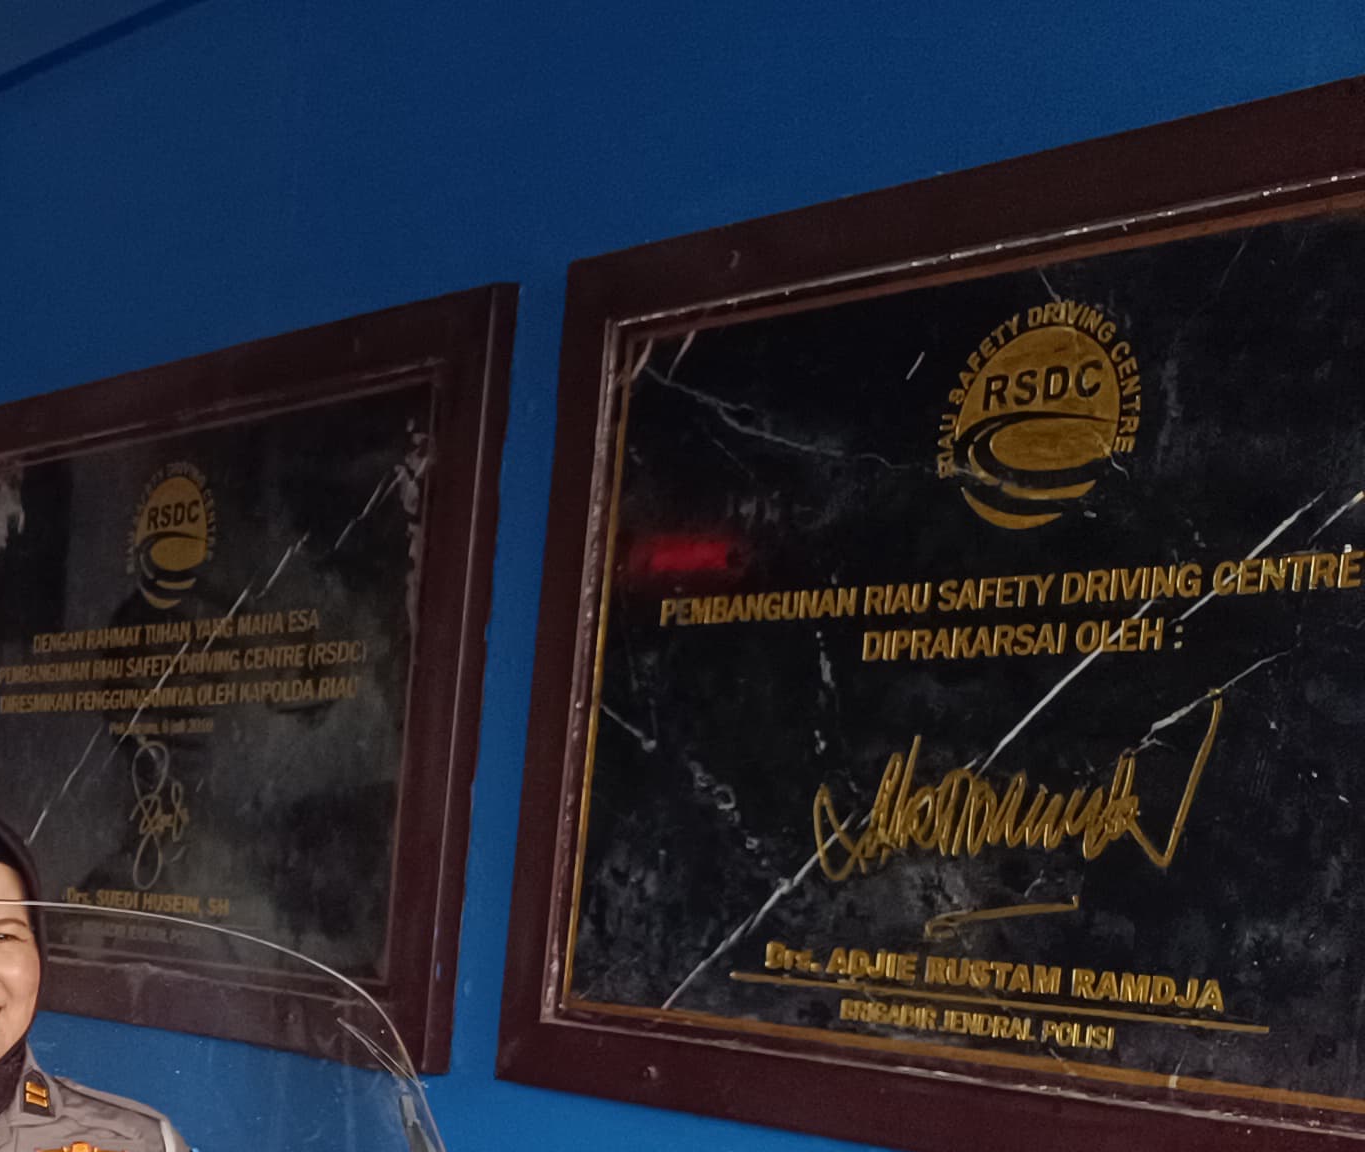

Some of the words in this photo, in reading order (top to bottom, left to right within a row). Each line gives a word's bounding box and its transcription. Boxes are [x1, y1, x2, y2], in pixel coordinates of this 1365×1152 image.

[937, 414, 958, 479] RIAU
[949, 313, 1019, 405] SAFETY
[1027, 300, 1117, 343] DRIVING
[1110, 341, 1142, 453] CENTRE
[983, 360, 1103, 411] RSDC
[147, 500, 200, 533] RSDC
[659, 586, 857, 628] PEMBANGUNAN
[864, 582, 932, 615] RIAU
[938, 572, 1055, 612] SAFETY
[1061, 563, 1202, 604] DRIVING
[1213, 551, 1365, 596] CENTRE
[33, 629, 85, 654] DENGAN
[87, 625, 140, 650] RAHMAT
[144, 622, 192, 644] TUHAN
[195, 617, 232, 641] YANG
[238, 613, 283, 635] MAHA
[288, 609, 319, 632] ESA
[862, 623, 1067, 662] DIPRAKARSAI
[1075, 616, 1164, 653] OLEH
[92, 658, 123, 680] RIAU
[125, 654, 176, 678] SAFETY
[179, 649, 240, 674] DRIVING
[244, 644, 306, 670] CENTRE
[308, 640, 367, 669] (RSDC)
[0, 690, 74, 713] DIRESMIKAN
[197, 683, 236, 705] OLEH
[240, 678, 316, 702] KAPOLDA
[319, 675, 361, 700] RIAU
[67, 886, 92, 905] Drs.
[96, 889, 139, 911] SUEDI
[208, 898, 230, 916] SH
[765, 941, 820, 972] Drs.
[825, 948, 919, 983] ADJIE
[925, 955, 1062, 995] RUSTAM
[1072, 967, 1226, 1012] RAMDJA
[939, 1010, 1036, 1042] JENDRAL
[1041, 1021, 1116, 1050] POLISI
